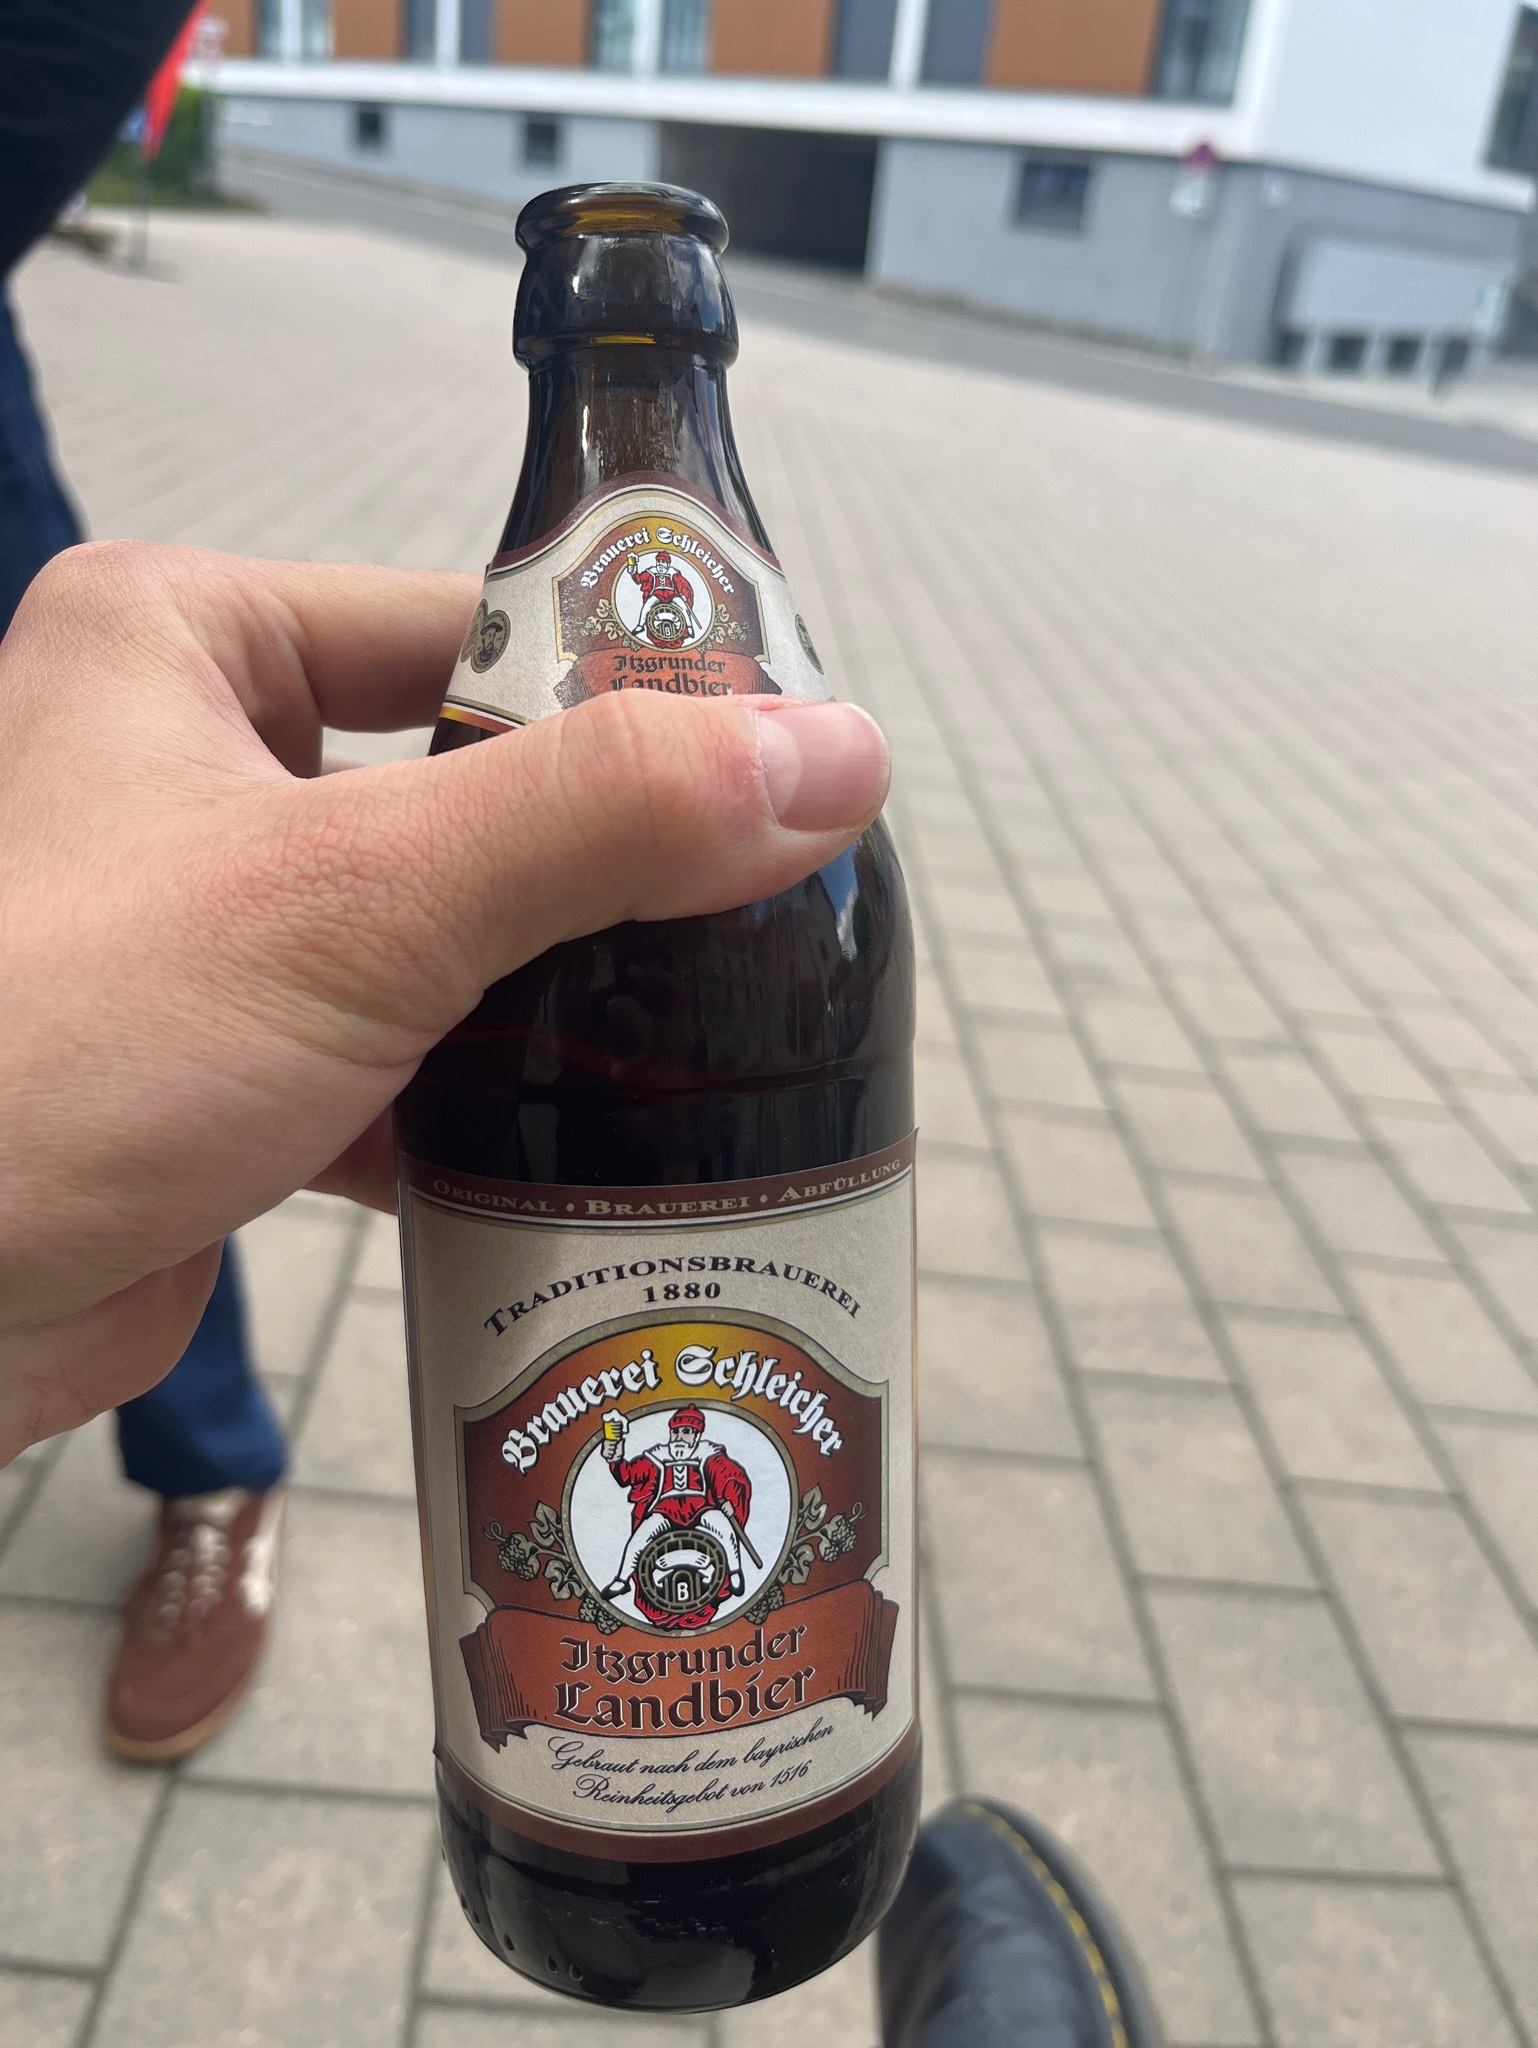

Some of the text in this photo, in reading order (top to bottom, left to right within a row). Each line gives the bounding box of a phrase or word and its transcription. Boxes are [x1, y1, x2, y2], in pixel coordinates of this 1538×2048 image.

[580, 527, 735, 595] Brauerei Schleicher
[613, 654, 726, 674] Itzgrunder
[433, 1158, 901, 1216] ORIGINAL BRAUEREI ABFÜLLUNG
[483, 1256, 862, 1337] TRADITIONSBRAUEREI
[643, 1281, 722, 1303] 1880
[501, 1345, 844, 1475] Brauerei Schleicher
[677, 1582, 689, 1601] B
[560, 1624, 808, 1685] Itzgrunder
[553, 1666, 816, 1730] Landbier
[547, 1715, 835, 1775] Gebraut nach dem bayrischen
[572, 1759, 812, 1813] Reinheitsgebot von 1516
